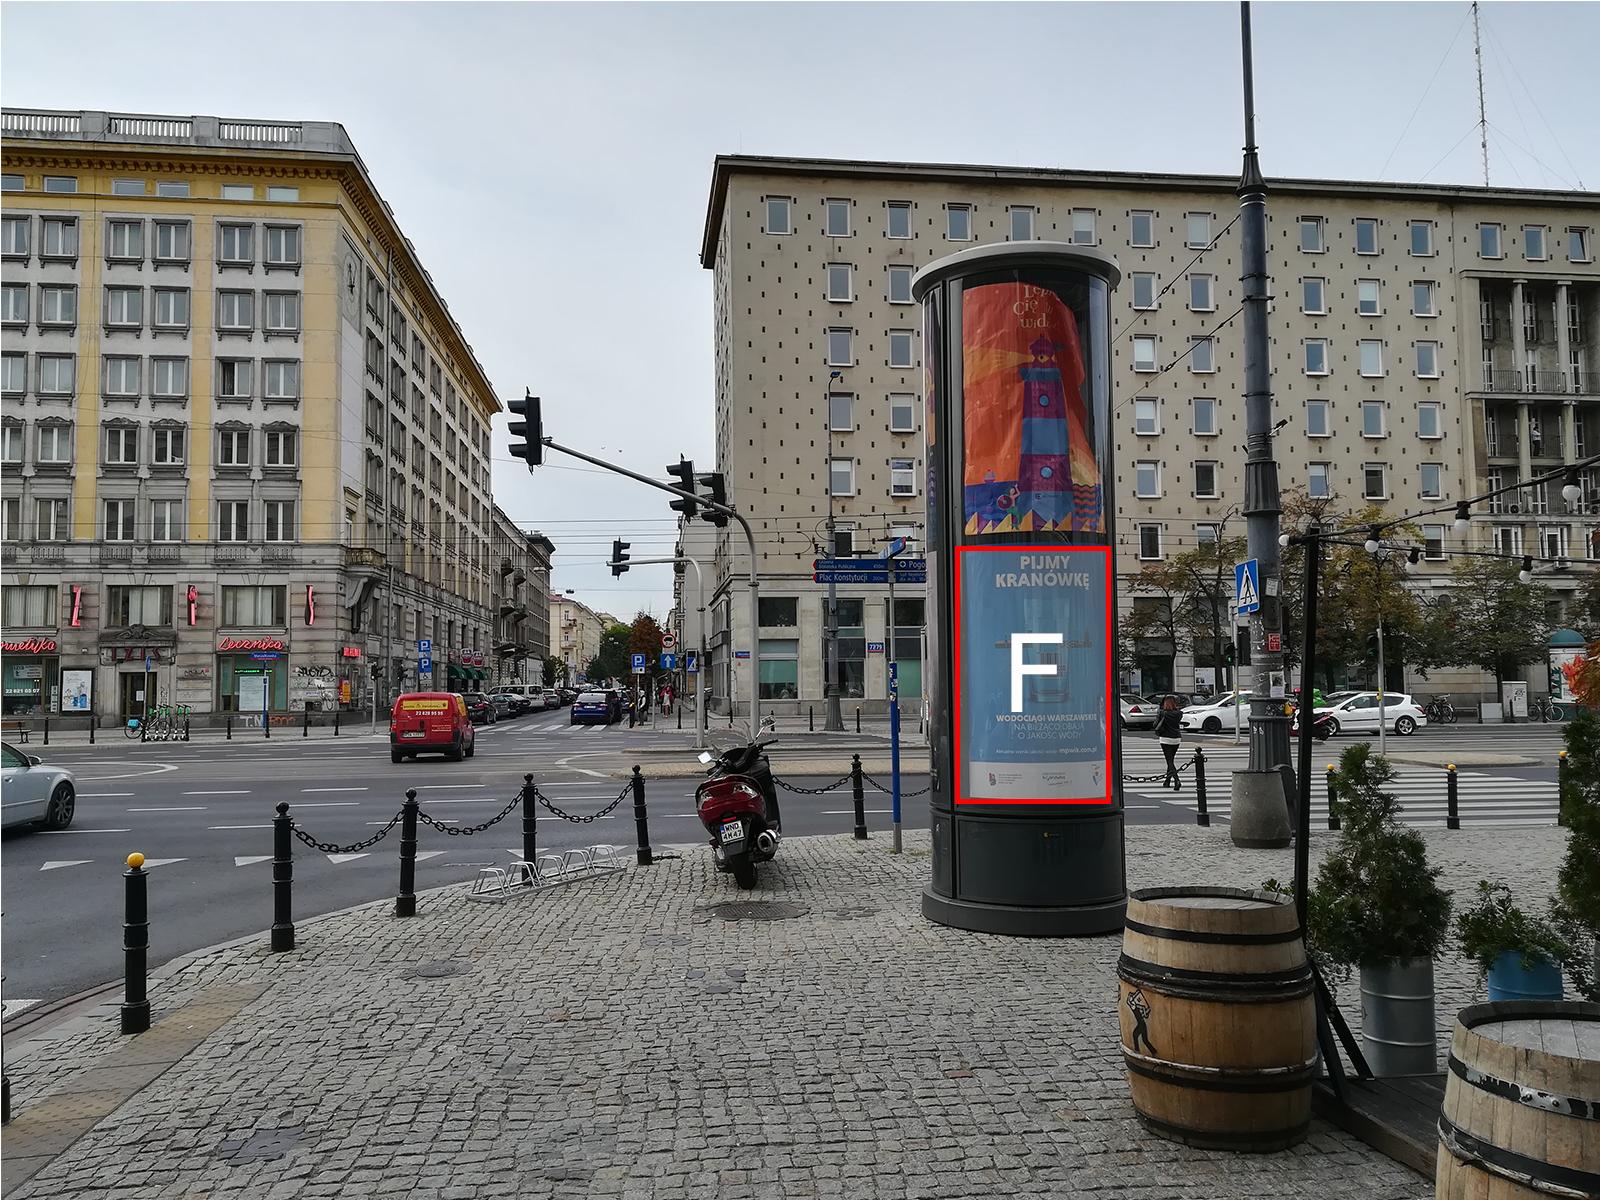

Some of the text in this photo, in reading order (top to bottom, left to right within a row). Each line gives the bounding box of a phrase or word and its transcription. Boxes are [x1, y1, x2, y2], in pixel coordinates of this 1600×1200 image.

[1020, 556, 1070, 569] PIJMY
[820, 573, 833, 581] Plac
[834, 573, 867, 583] Konstytucji
[996, 569, 1090, 590] KRANÓWKĘ
[219, 634, 284, 651] Lecznica
[996, 713, 1097, 723] WODOCIĄGI WARSZAWSKIE
